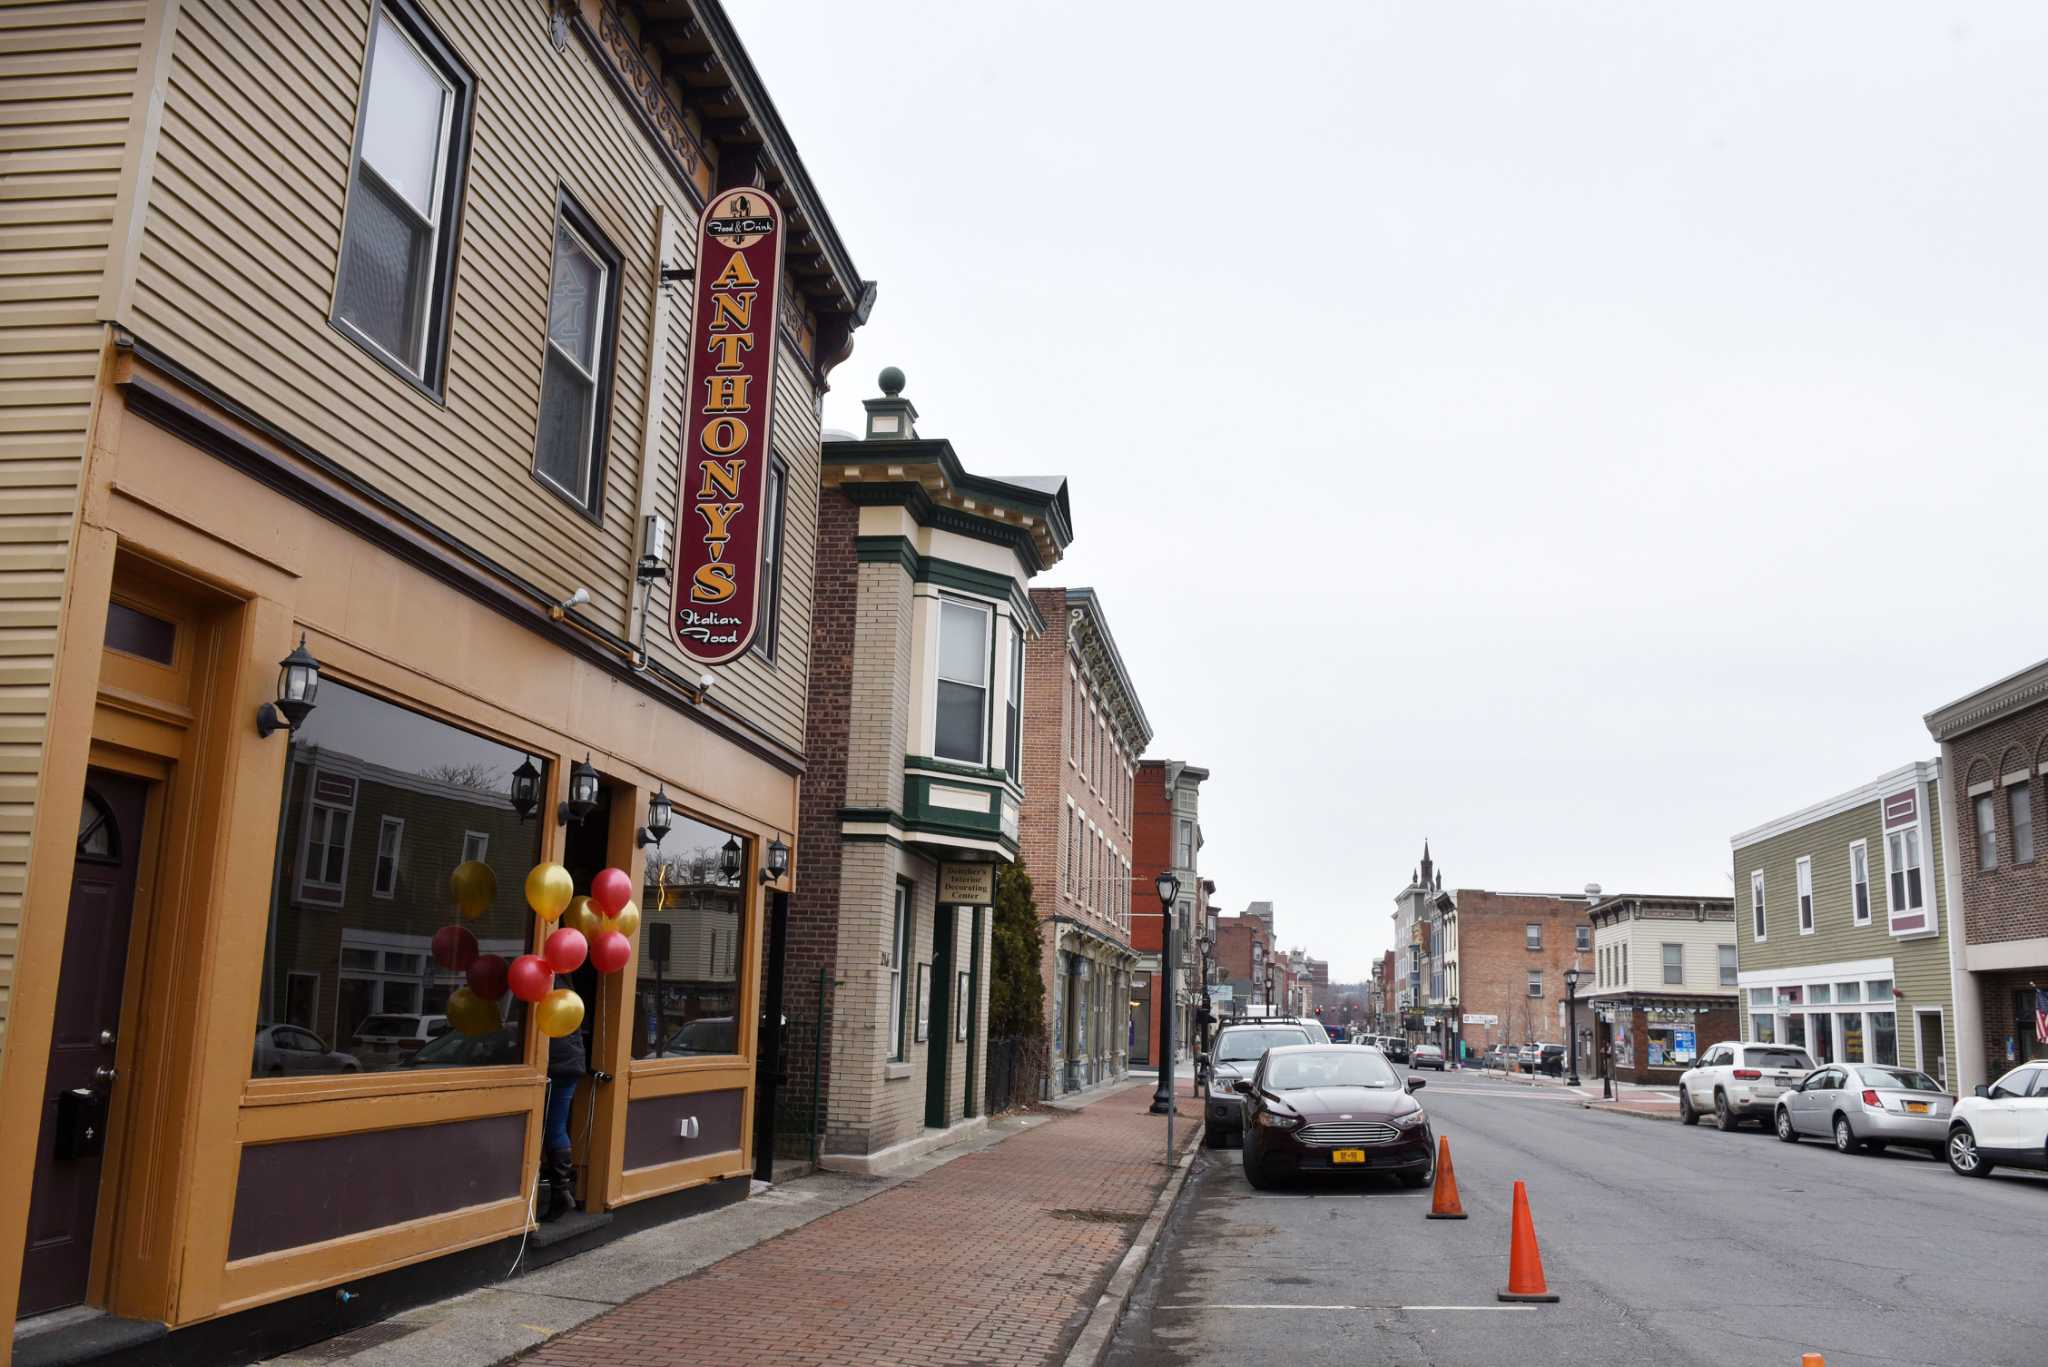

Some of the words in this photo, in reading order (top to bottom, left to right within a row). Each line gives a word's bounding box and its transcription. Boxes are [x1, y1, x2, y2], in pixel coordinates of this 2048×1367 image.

[708, 221, 734, 232] Food
[742, 220, 772, 231] Drink
[691, 251, 759, 604] ANTHONY'S
[680, 608, 742, 626] Italian
[680, 627, 738, 644] Food
[945, 883, 988, 893] Decorating
[951, 892, 979, 900] Center
